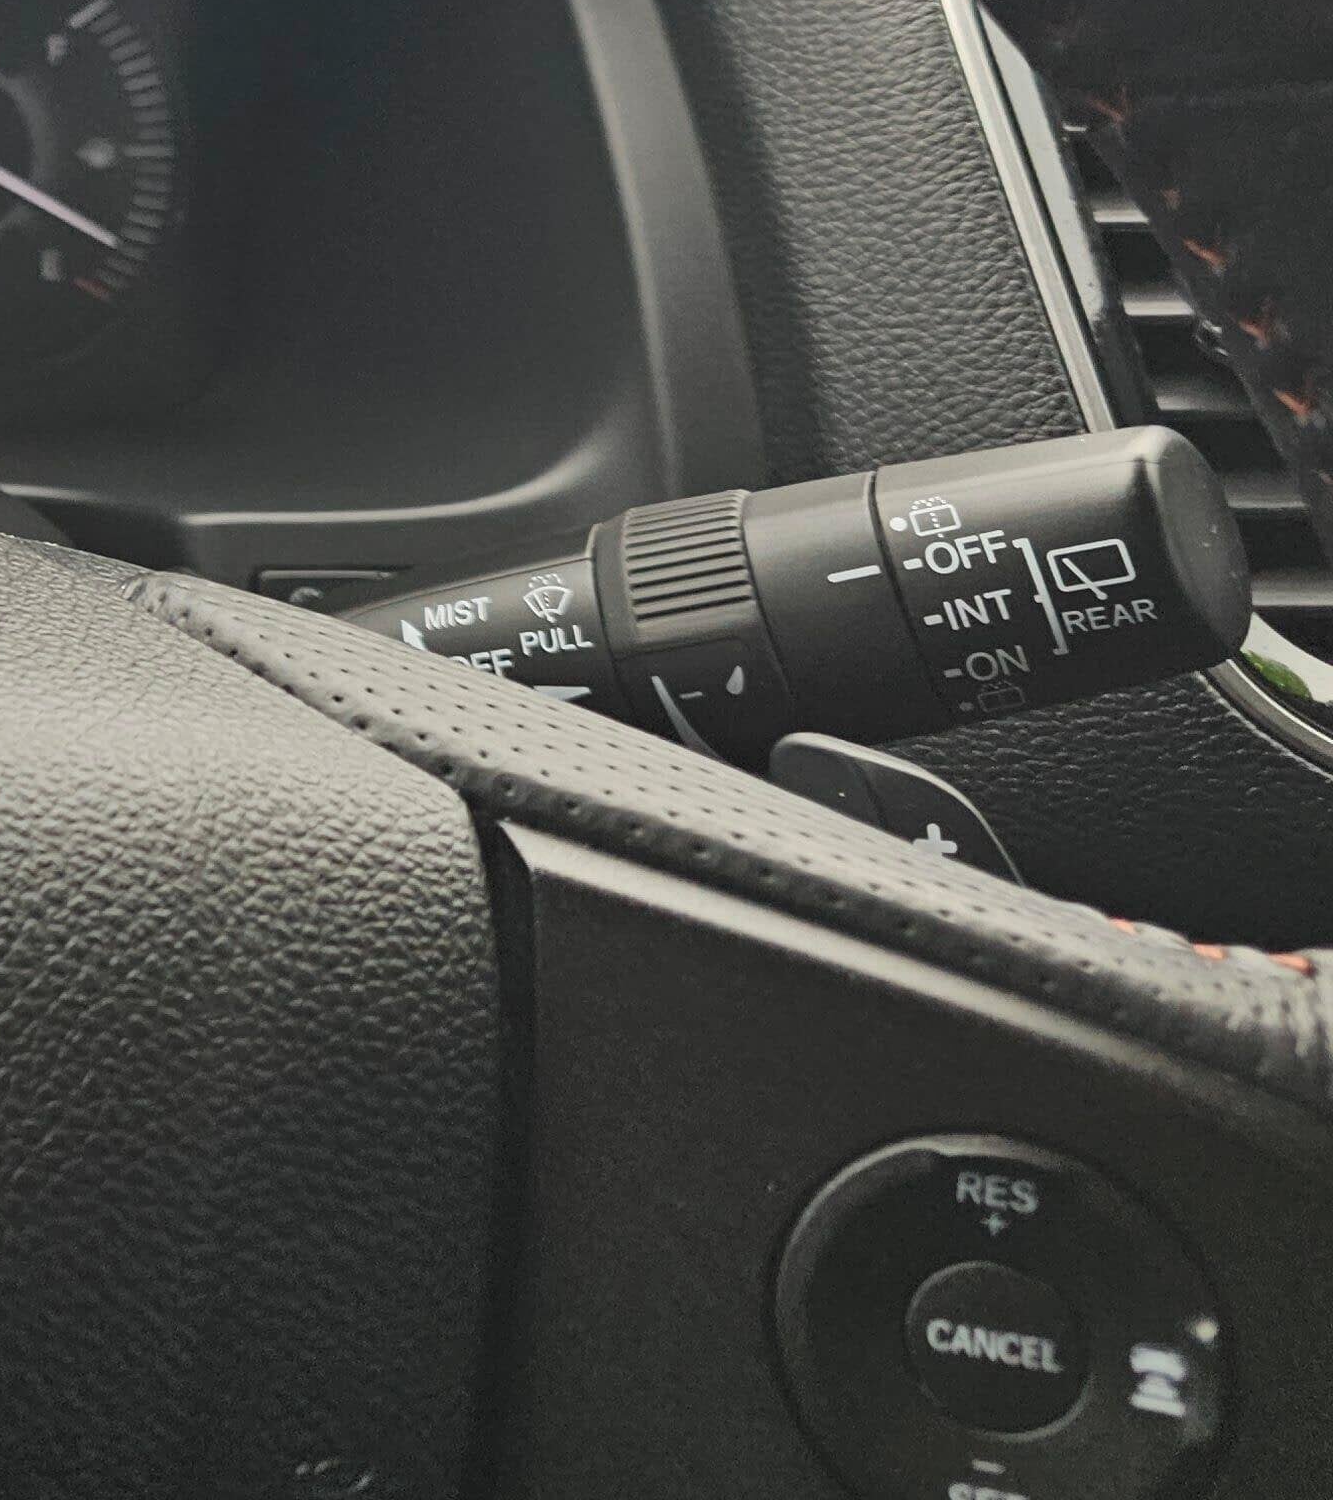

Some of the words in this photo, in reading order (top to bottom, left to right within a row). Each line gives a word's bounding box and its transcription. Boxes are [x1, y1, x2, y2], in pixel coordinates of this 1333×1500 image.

[925, 530, 1007, 574] OFF
[424, 596, 491, 631] MIST
[942, 588, 1012, 631] INT
[1062, 599, 1158, 634] REAR
[519, 624, 594, 658] PULL
[965, 645, 1031, 681] ON
[957, 1171, 1039, 1214] RES
[926, 1317, 1065, 1374] CANCEL
